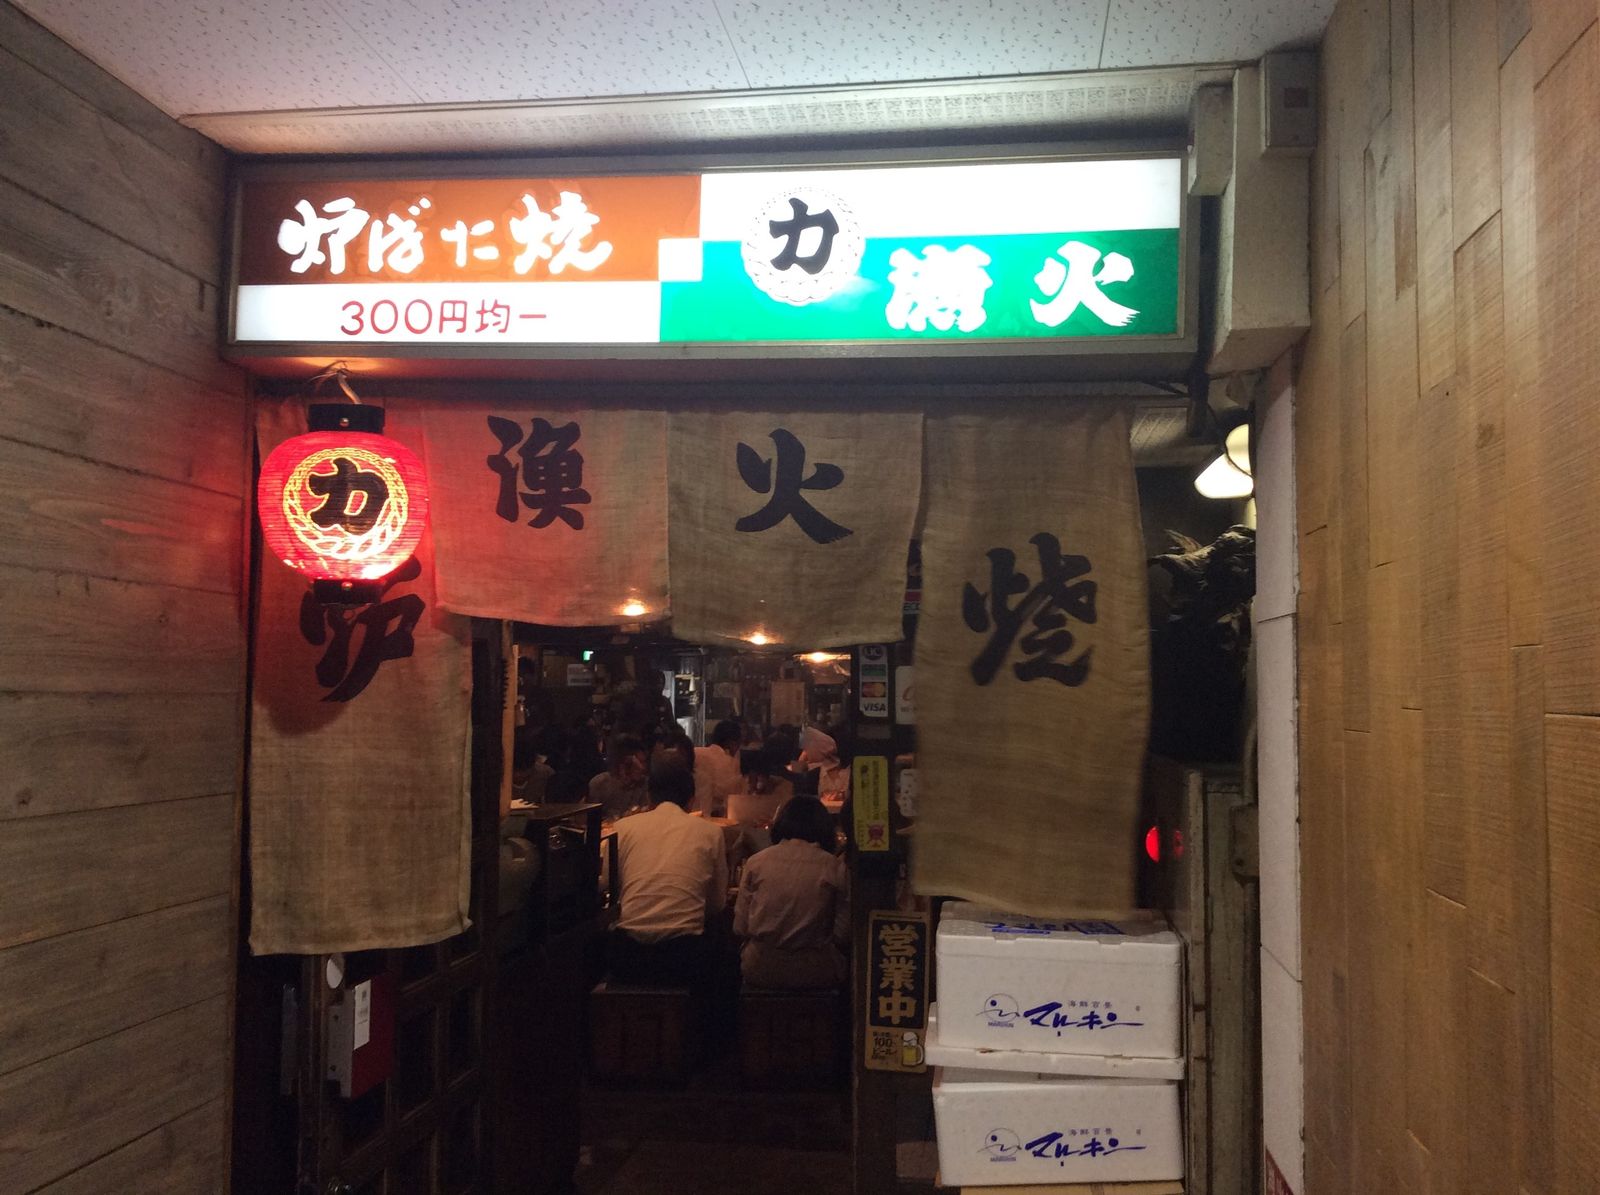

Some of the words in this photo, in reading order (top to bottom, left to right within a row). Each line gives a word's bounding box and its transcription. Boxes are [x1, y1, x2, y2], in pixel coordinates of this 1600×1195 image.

[277, 191, 613, 276] 炉ばた焼
[341, 298, 548, 335] 300円均一
[863, 703, 886, 712] VISA
[878, 923, 919, 1025] 営業中
